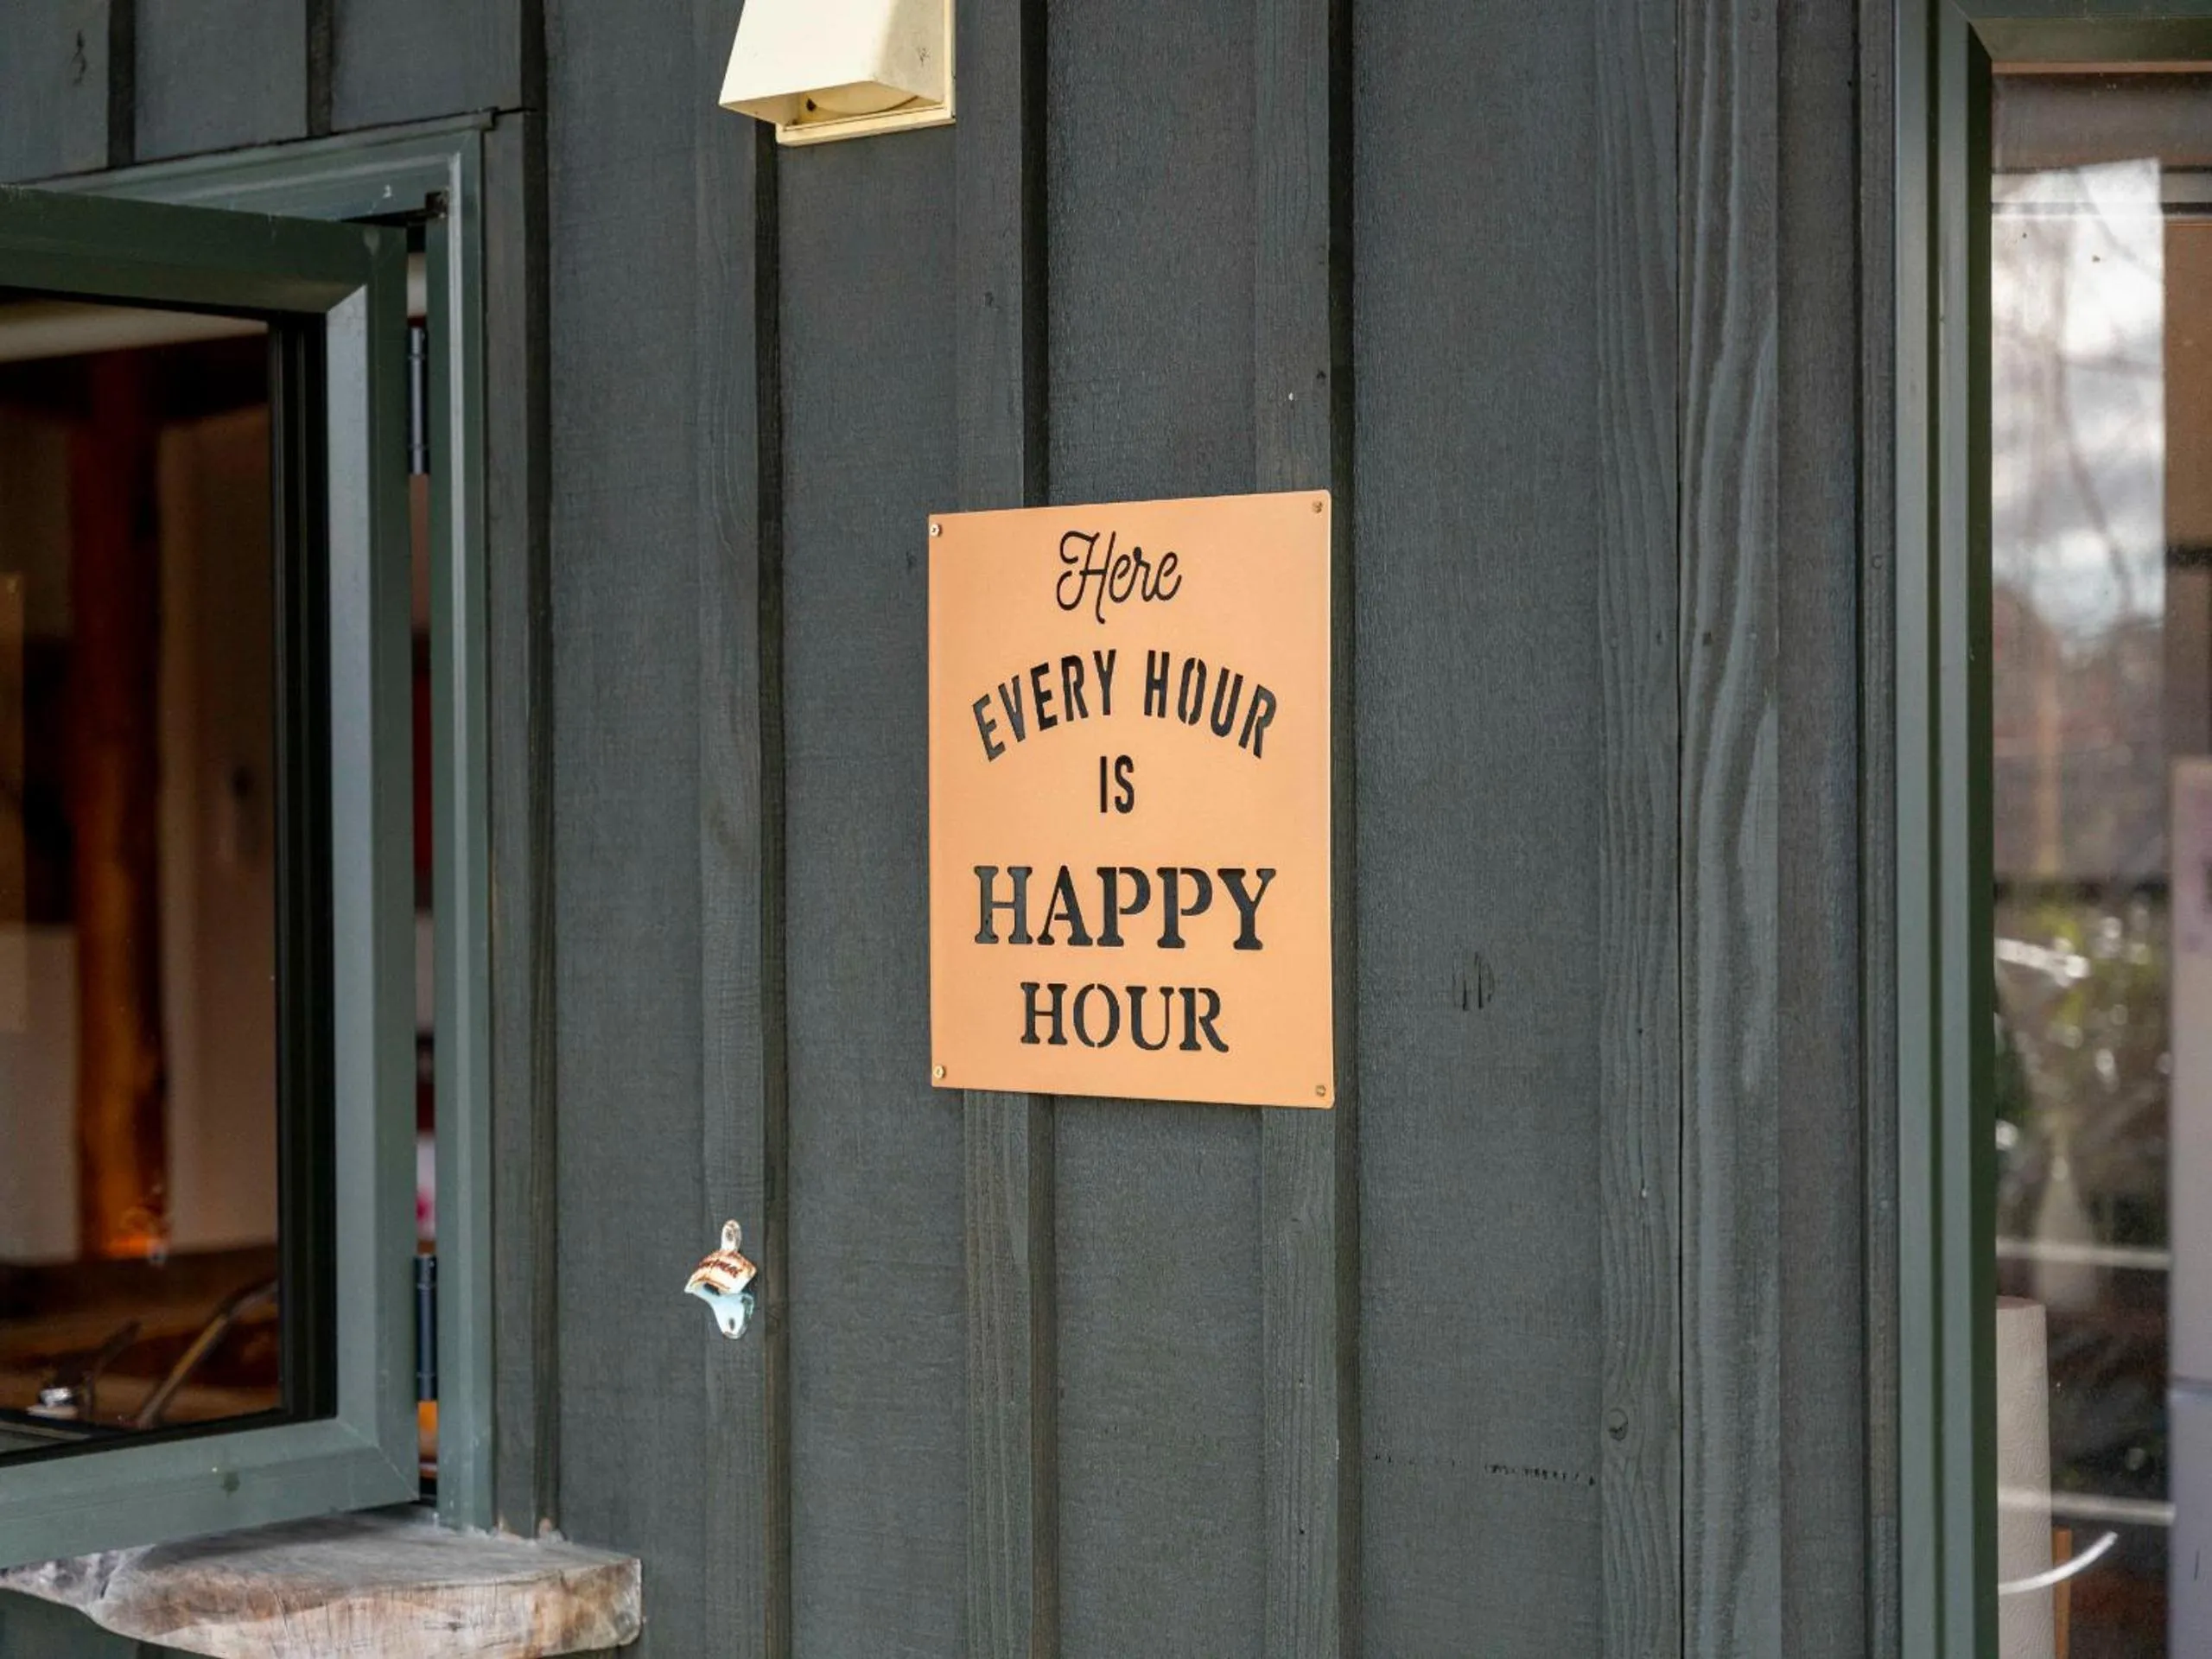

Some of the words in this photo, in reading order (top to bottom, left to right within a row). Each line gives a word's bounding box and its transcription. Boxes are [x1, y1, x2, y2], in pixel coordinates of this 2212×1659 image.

[1057, 531, 1182, 624] Here
[972, 649, 1117, 761] EVERY
[1144, 650, 1276, 759] HOUR
[1100, 755, 1134, 813] IS
[974, 865, 1276, 950] HAPPY
[1020, 982, 1229, 1052] HOUR
